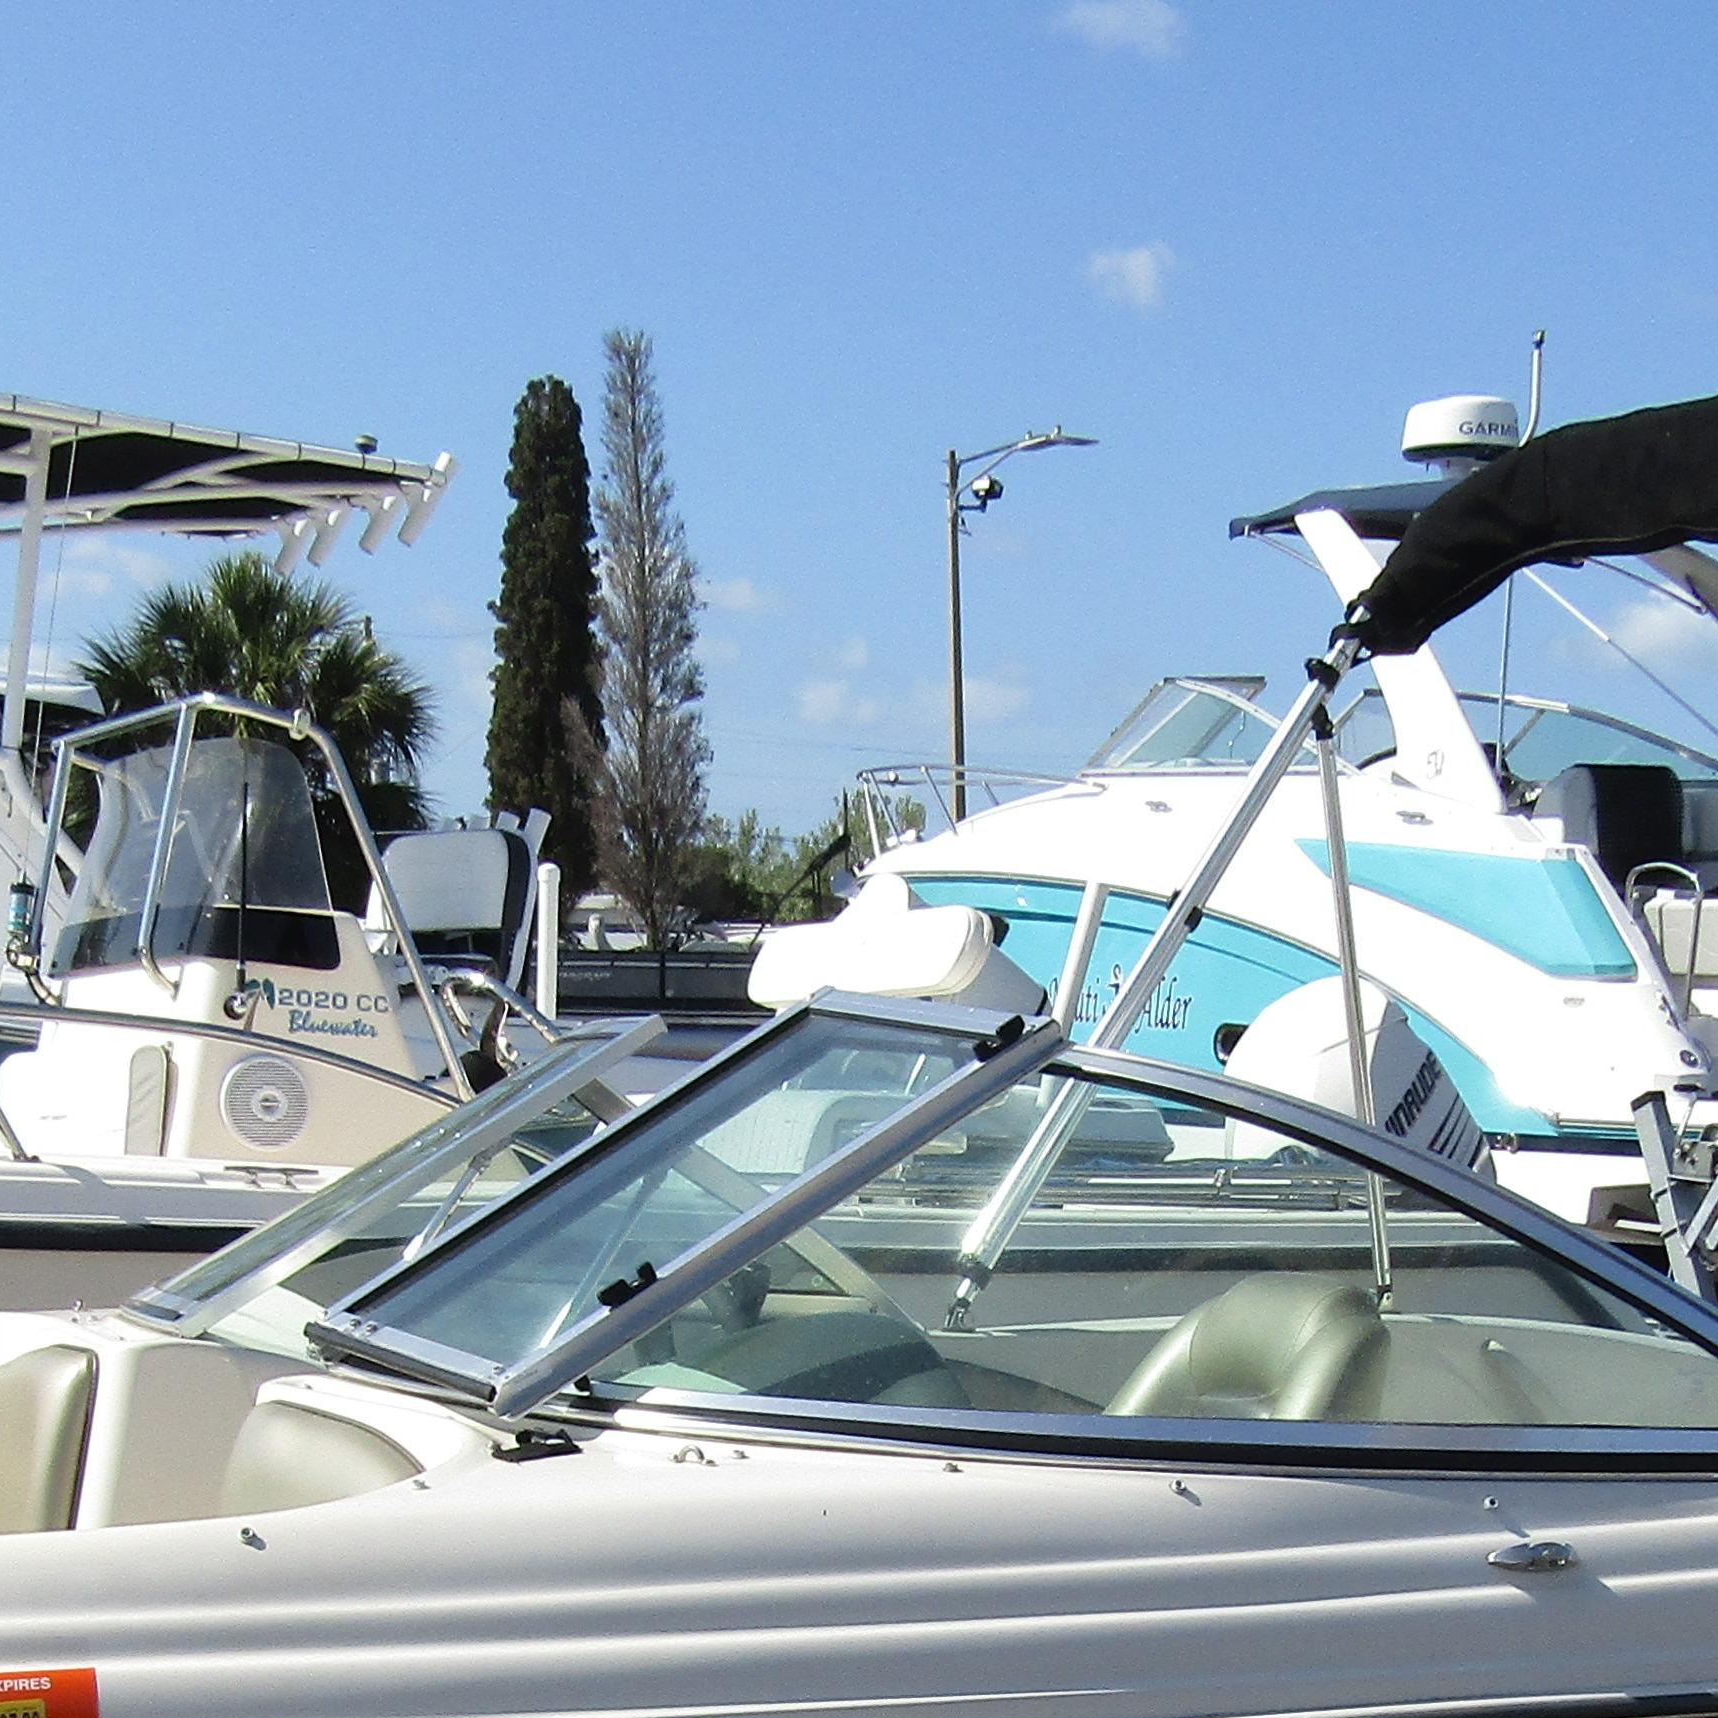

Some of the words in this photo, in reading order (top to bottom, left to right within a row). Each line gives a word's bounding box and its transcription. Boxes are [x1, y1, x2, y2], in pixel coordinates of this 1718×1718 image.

[279, 988, 347, 1009] 2020
[356, 994, 389, 1013] CC
[288, 1009, 379, 1037] Bluewater
